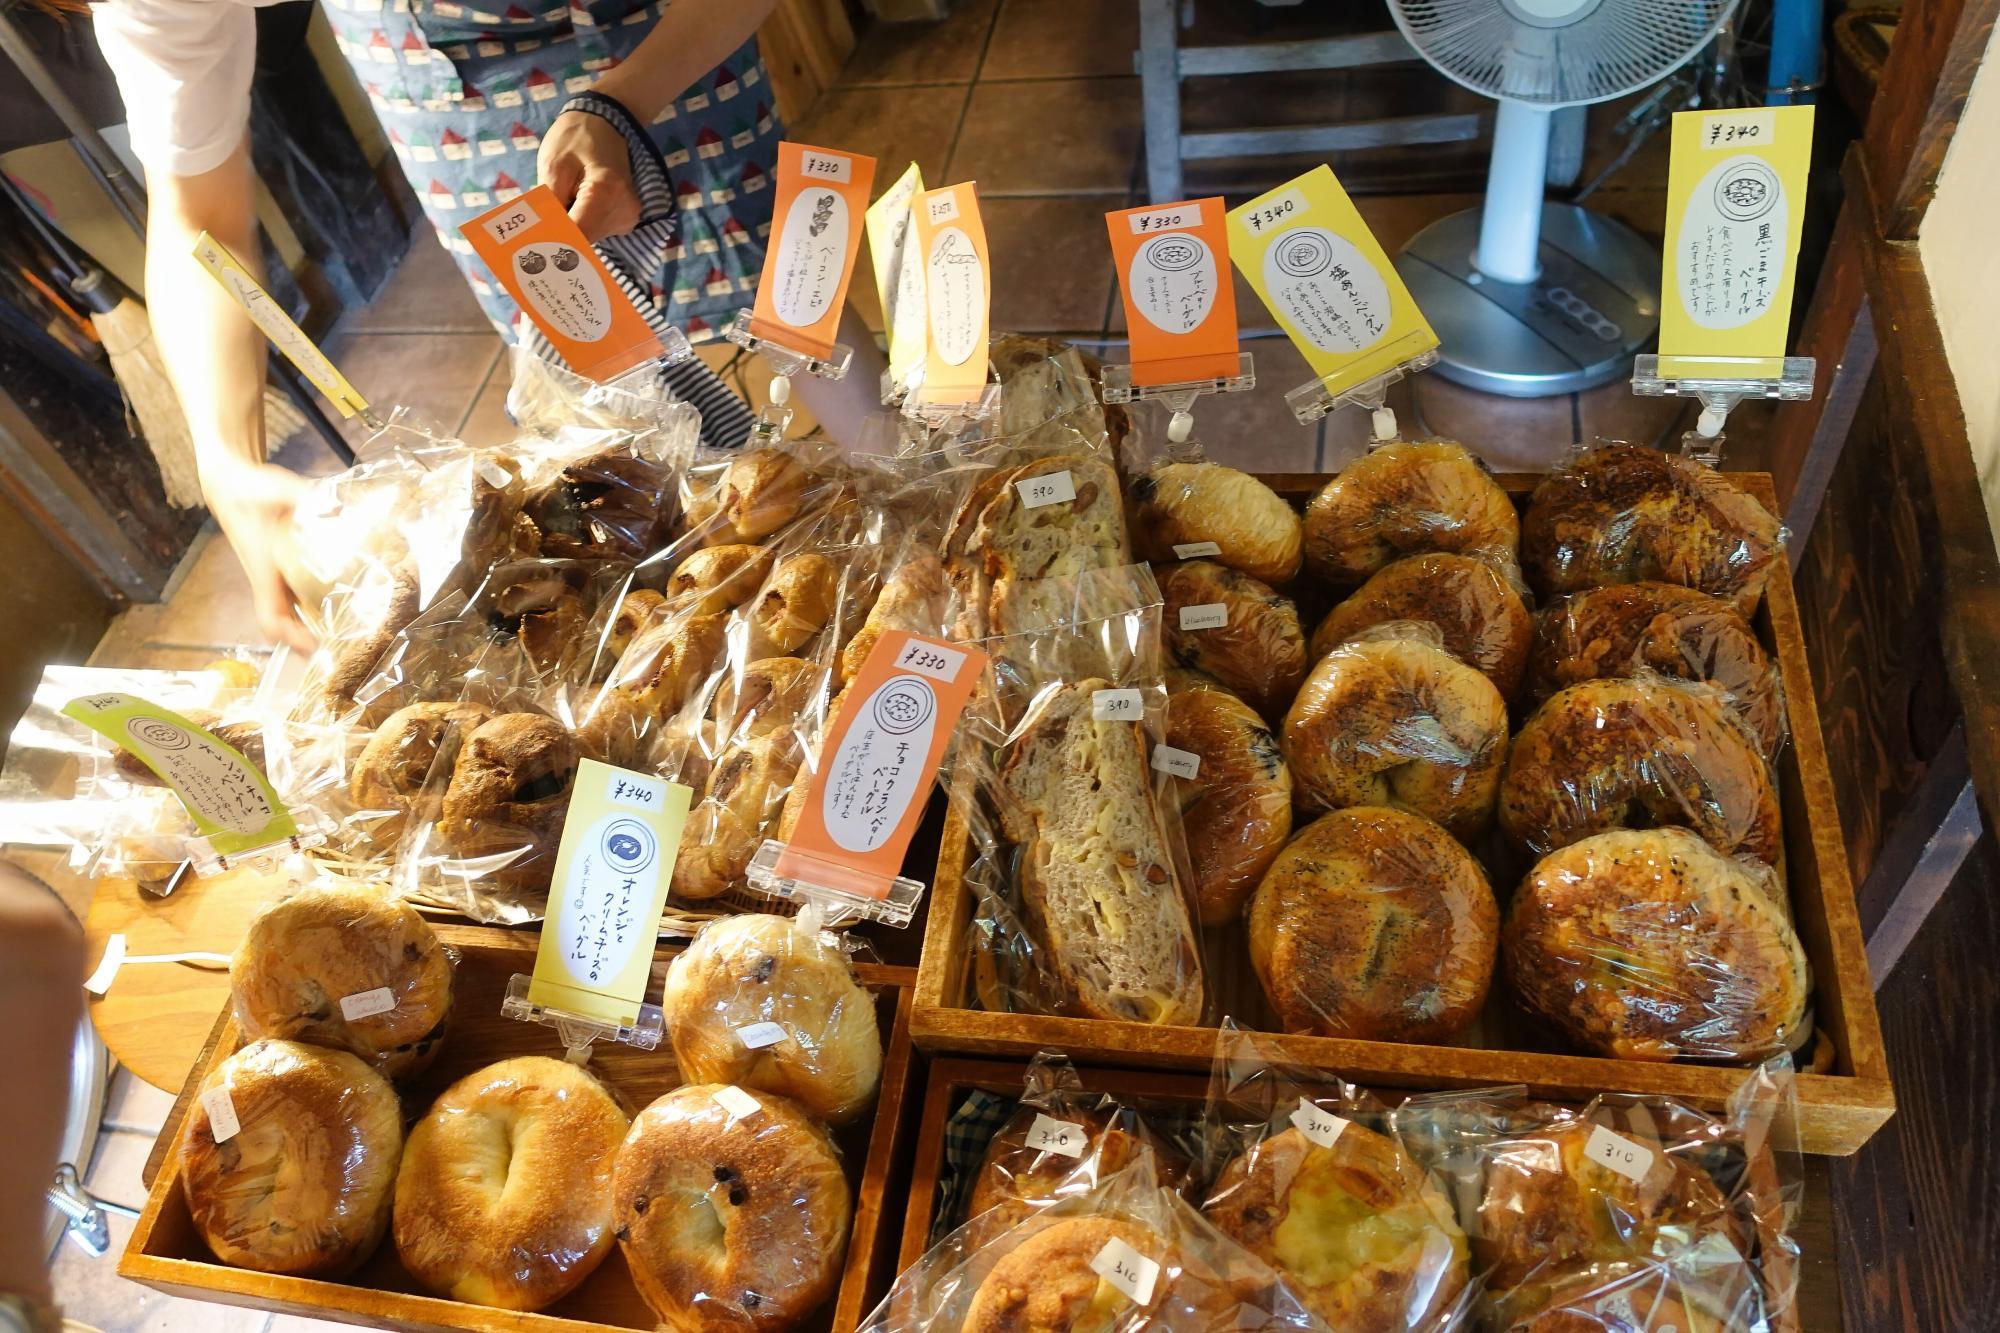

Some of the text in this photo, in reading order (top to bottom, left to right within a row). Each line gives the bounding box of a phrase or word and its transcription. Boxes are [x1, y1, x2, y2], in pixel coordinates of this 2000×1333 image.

[1711, 124, 1759, 144] ¥340
[808, 158, 839, 173] ¥330
[496, 214, 526, 239] ¥250
[1140, 216, 1181, 231] ¥330
[1249, 200, 1293, 230] ¥340
[809, 247, 835, 307] ベーコン・エピ
[1756, 223, 1772, 307] 黒ごまチーズ
[1329, 264, 1384, 336] 塩あんこベーグル
[1738, 267, 1754, 315] ベーグル
[1180, 294, 1196, 328] ベーグル
[1032, 487, 1054, 498] 390
[904, 647, 945, 670] ¥330
[1108, 700, 1129, 711] 390
[221, 774, 254, 816] ベーグル
[615, 780, 652, 802] ¥340
[861, 767, 888, 815] ベーグル
[616, 878, 637, 943] オレンジと
[571, 914, 595, 959] ベーグル
[590, 893, 614, 981] クリームチーズの
[1040, 1127, 1070, 1145] 310
[1305, 1119, 1331, 1137] 310
[1605, 1141, 1636, 1163] 310
